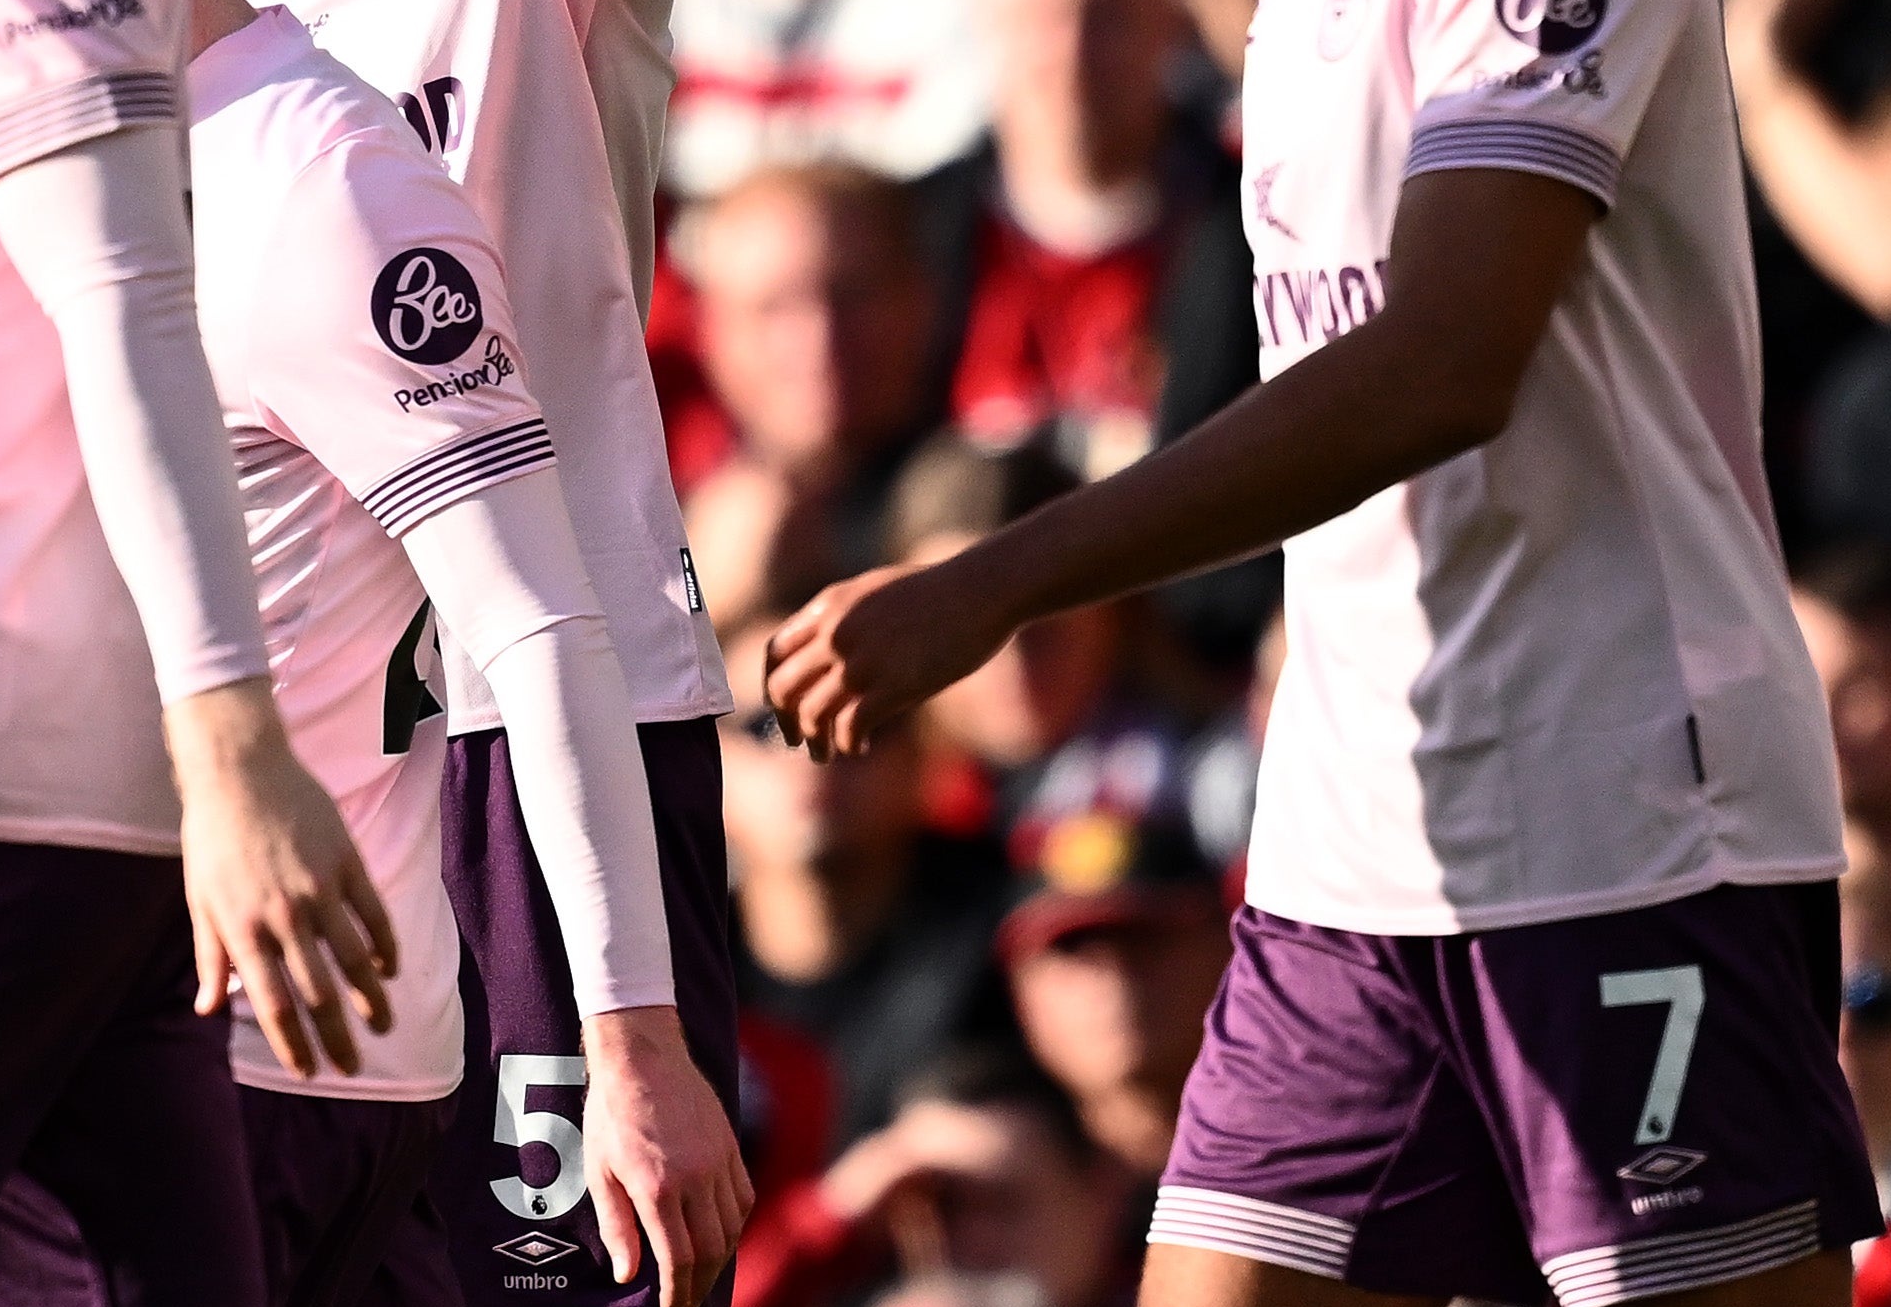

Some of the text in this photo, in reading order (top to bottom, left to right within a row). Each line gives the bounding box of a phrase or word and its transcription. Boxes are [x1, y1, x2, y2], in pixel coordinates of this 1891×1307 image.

[388, 255, 477, 351] Bee
[1598, 963, 1706, 1145] 7
[489, 1054, 590, 1220] 5
[503, 1272, 569, 1291] umbro
